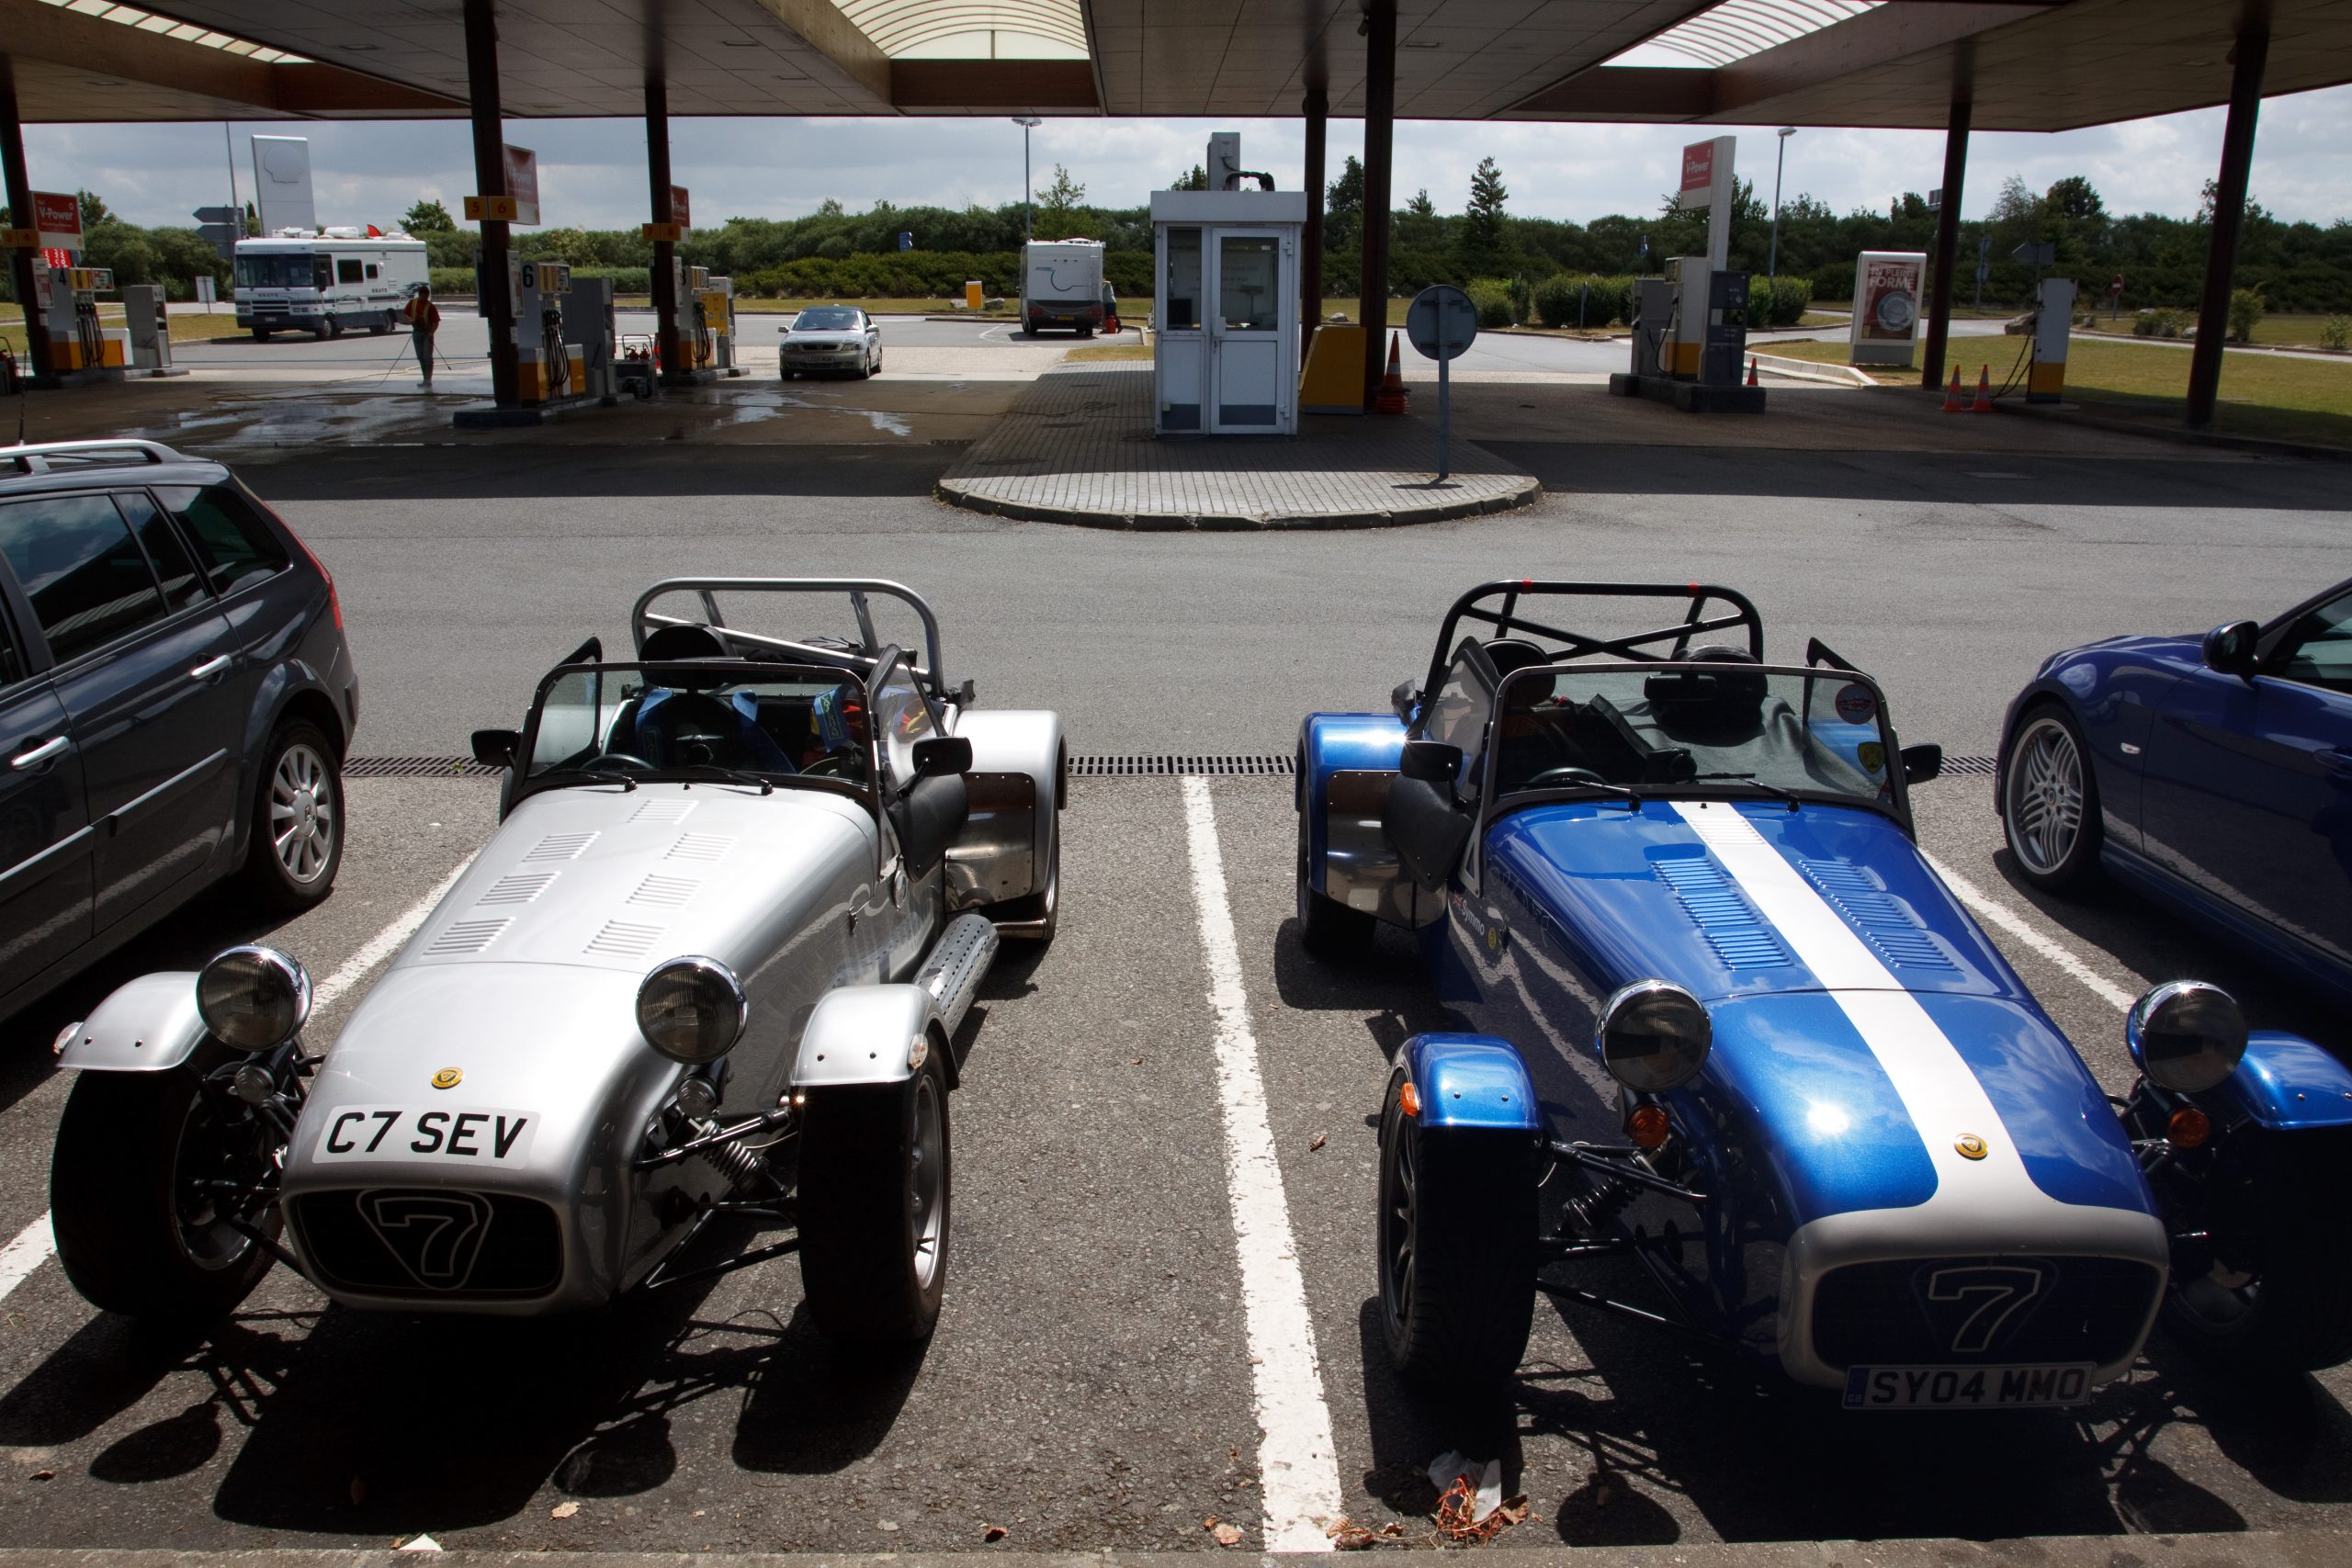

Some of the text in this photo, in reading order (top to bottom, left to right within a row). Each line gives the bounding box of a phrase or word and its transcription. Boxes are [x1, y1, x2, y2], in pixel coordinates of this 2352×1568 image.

[40, 207, 74, 220] V-Power
[471, 202, 481, 213] 5
[498, 202, 506, 213] 6
[58, 267, 66, 286] 4
[522, 265, 535, 288] 6
[1884, 266, 1916, 277] PLEINE
[1869, 276, 1917, 289] FORME
[326, 1111, 528, 1159] C7 SEV
[374, 1196, 479, 1277] 7
[1928, 1266, 2042, 1353] 7
[1871, 1368, 2086, 1404] SY04 MMO
[1847, 1393, 1862, 1404] GB
